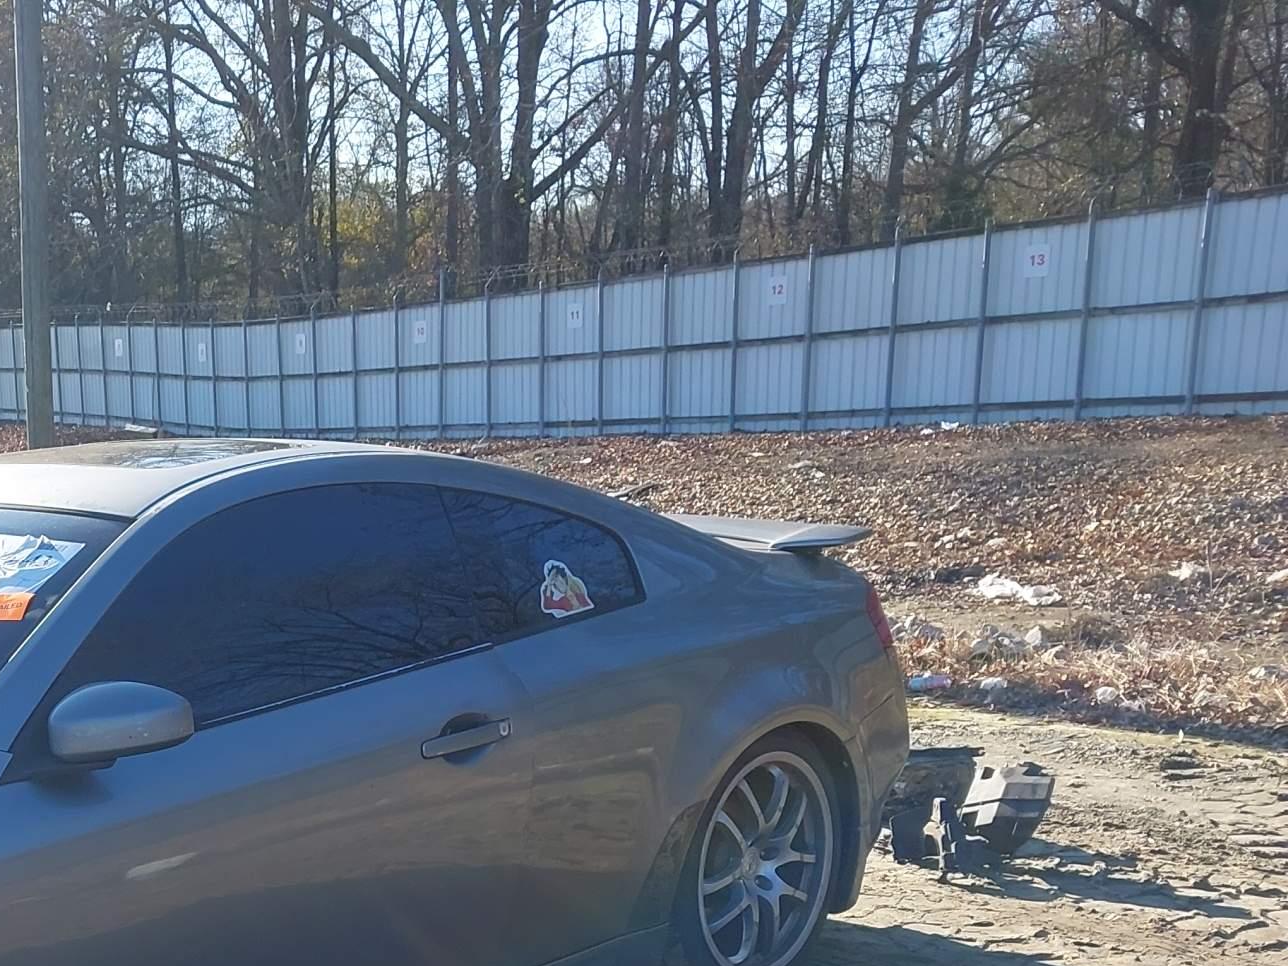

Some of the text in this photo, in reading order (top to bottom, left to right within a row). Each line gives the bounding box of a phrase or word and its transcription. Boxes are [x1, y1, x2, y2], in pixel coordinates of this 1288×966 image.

[1030, 254, 1045, 266] 13
[772, 284, 784, 295] 12
[570, 310, 580, 320] 11
